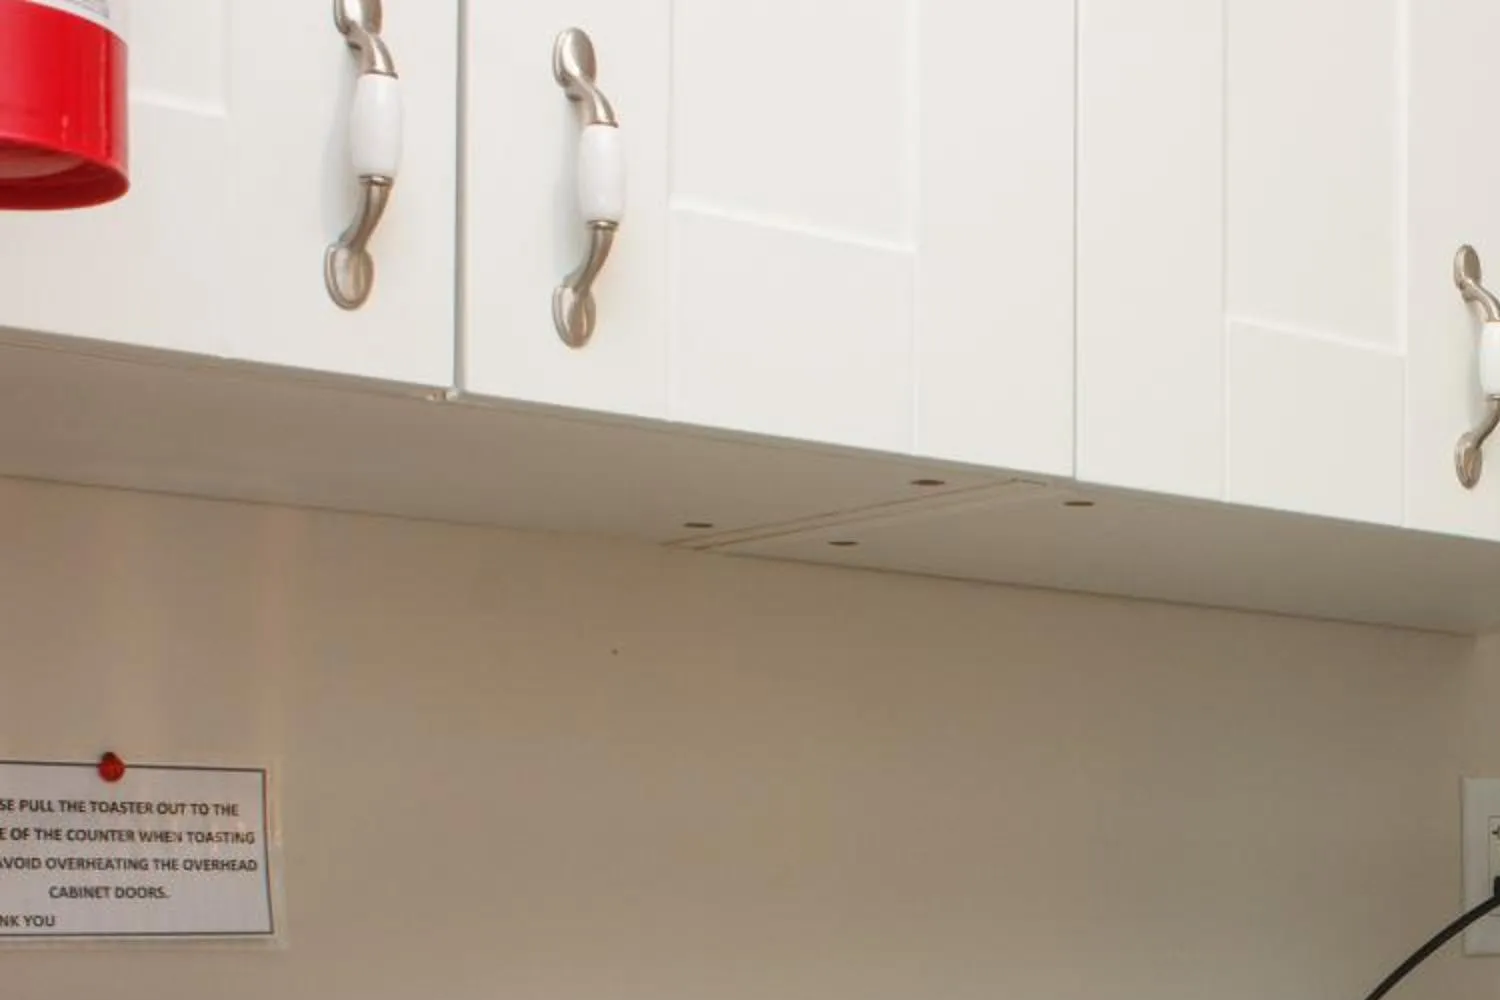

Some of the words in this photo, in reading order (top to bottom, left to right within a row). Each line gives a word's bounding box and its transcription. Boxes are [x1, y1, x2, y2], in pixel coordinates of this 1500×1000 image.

[18, 799, 54, 813] PULL
[58, 800, 87, 813] THE
[90, 801, 153, 815] TOASTER
[156, 803, 186, 815] OUT
[190, 803, 210, 815] TO
[213, 803, 240, 817] THE
[10, 828, 31, 841] OF
[34, 828, 62, 841] THE
[66, 829, 135, 842] COUNTER
[139, 831, 183, 843] WHEN
[187, 832, 256, 845] TOASTING
[45, 857, 149, 871] OVERHEATING
[152, 859, 180, 871] THE
[183, 859, 258, 872] OVERHEAD
[49, 885, 111, 899] CABINET
[23, 915, 56, 928] YOU
